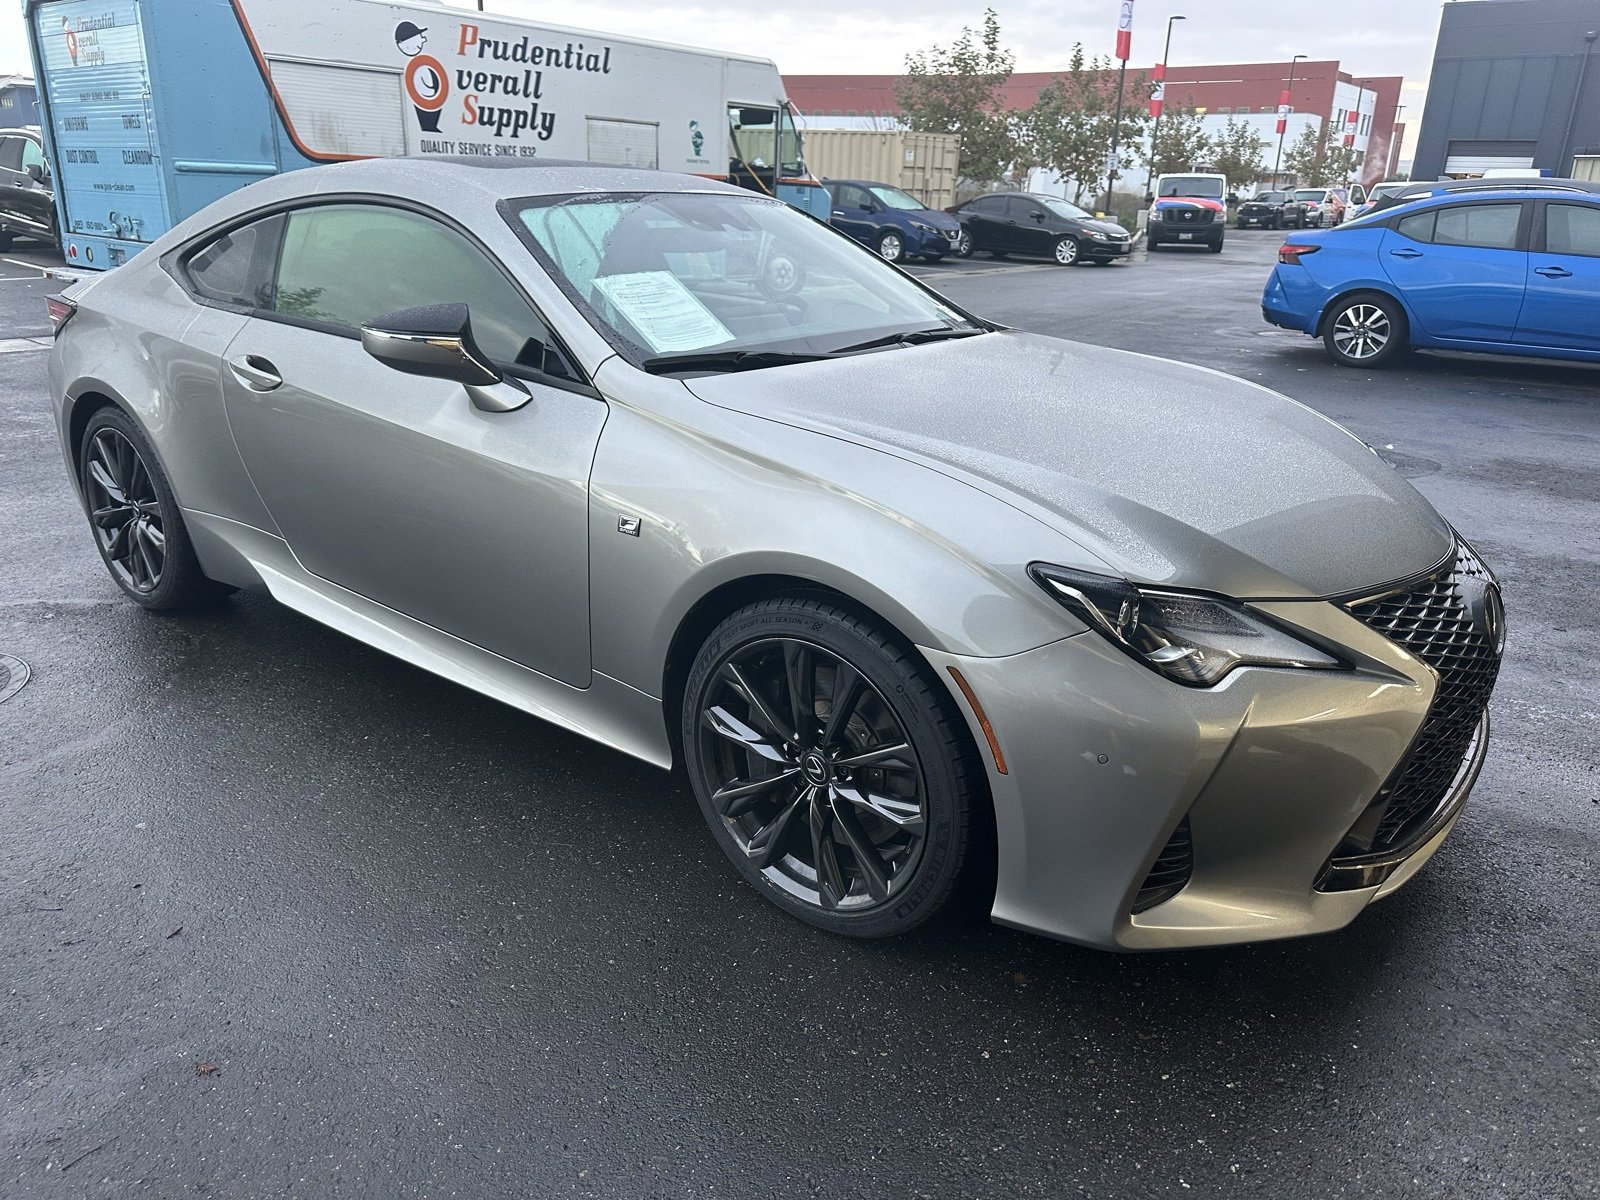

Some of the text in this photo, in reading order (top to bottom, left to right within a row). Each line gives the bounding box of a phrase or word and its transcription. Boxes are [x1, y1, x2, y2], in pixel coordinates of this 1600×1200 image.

[77, 12, 115, 31] Prudential
[82, 47, 105, 66] Supply
[457, 24, 611, 74] Prudential
[64, 114, 141, 131] UNIFORMS TOWELS
[461, 94, 555, 141] Supply
[66, 150, 153, 165] DUST CONTROL CLEANROOM
[420, 140, 537, 157] QUALITY SERVICE SINCE 1932
[739, 619, 760, 631] SPORT
[760, 617, 773, 625] ALL
[774, 616, 803, 626] SEASON
